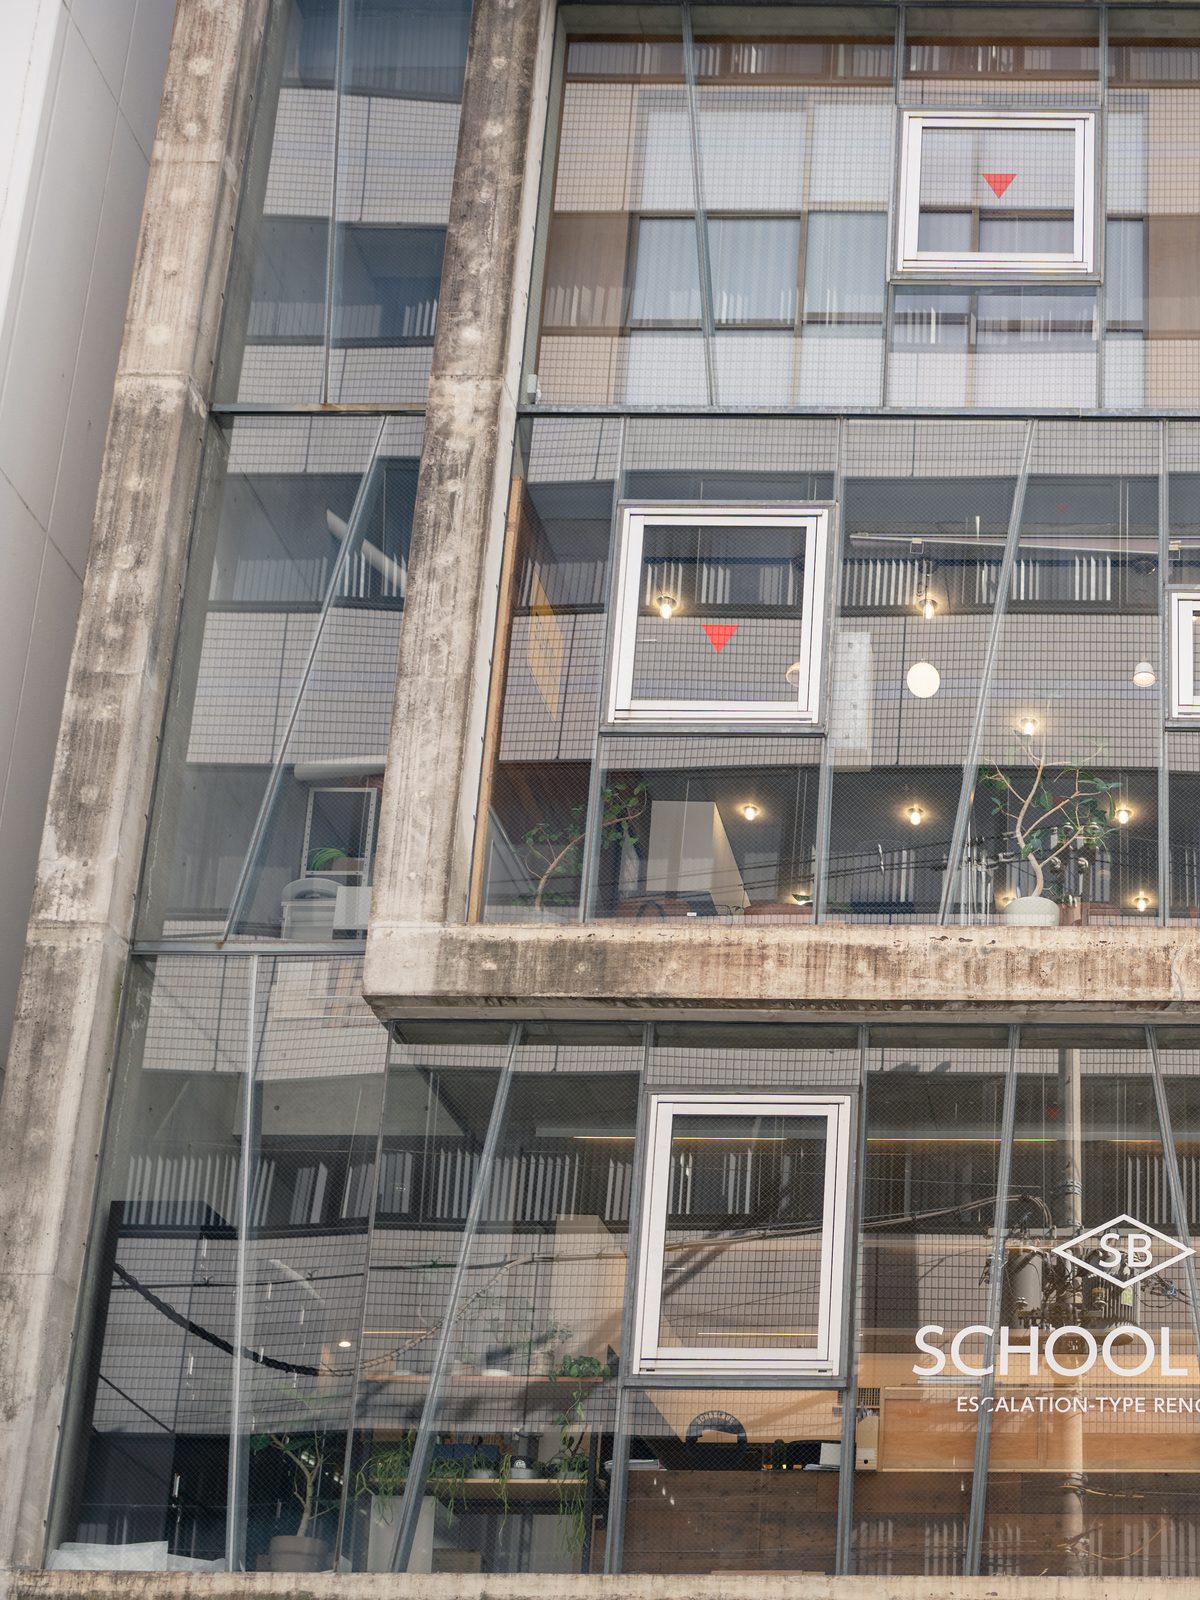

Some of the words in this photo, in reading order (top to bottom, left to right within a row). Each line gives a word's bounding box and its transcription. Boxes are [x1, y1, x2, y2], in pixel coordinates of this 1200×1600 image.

[1098, 1232, 1153, 1268] SB
[912, 1324, 1188, 1377] SCHOOL
[957, 1396, 1146, 1413] ESCALATION-TYPE
